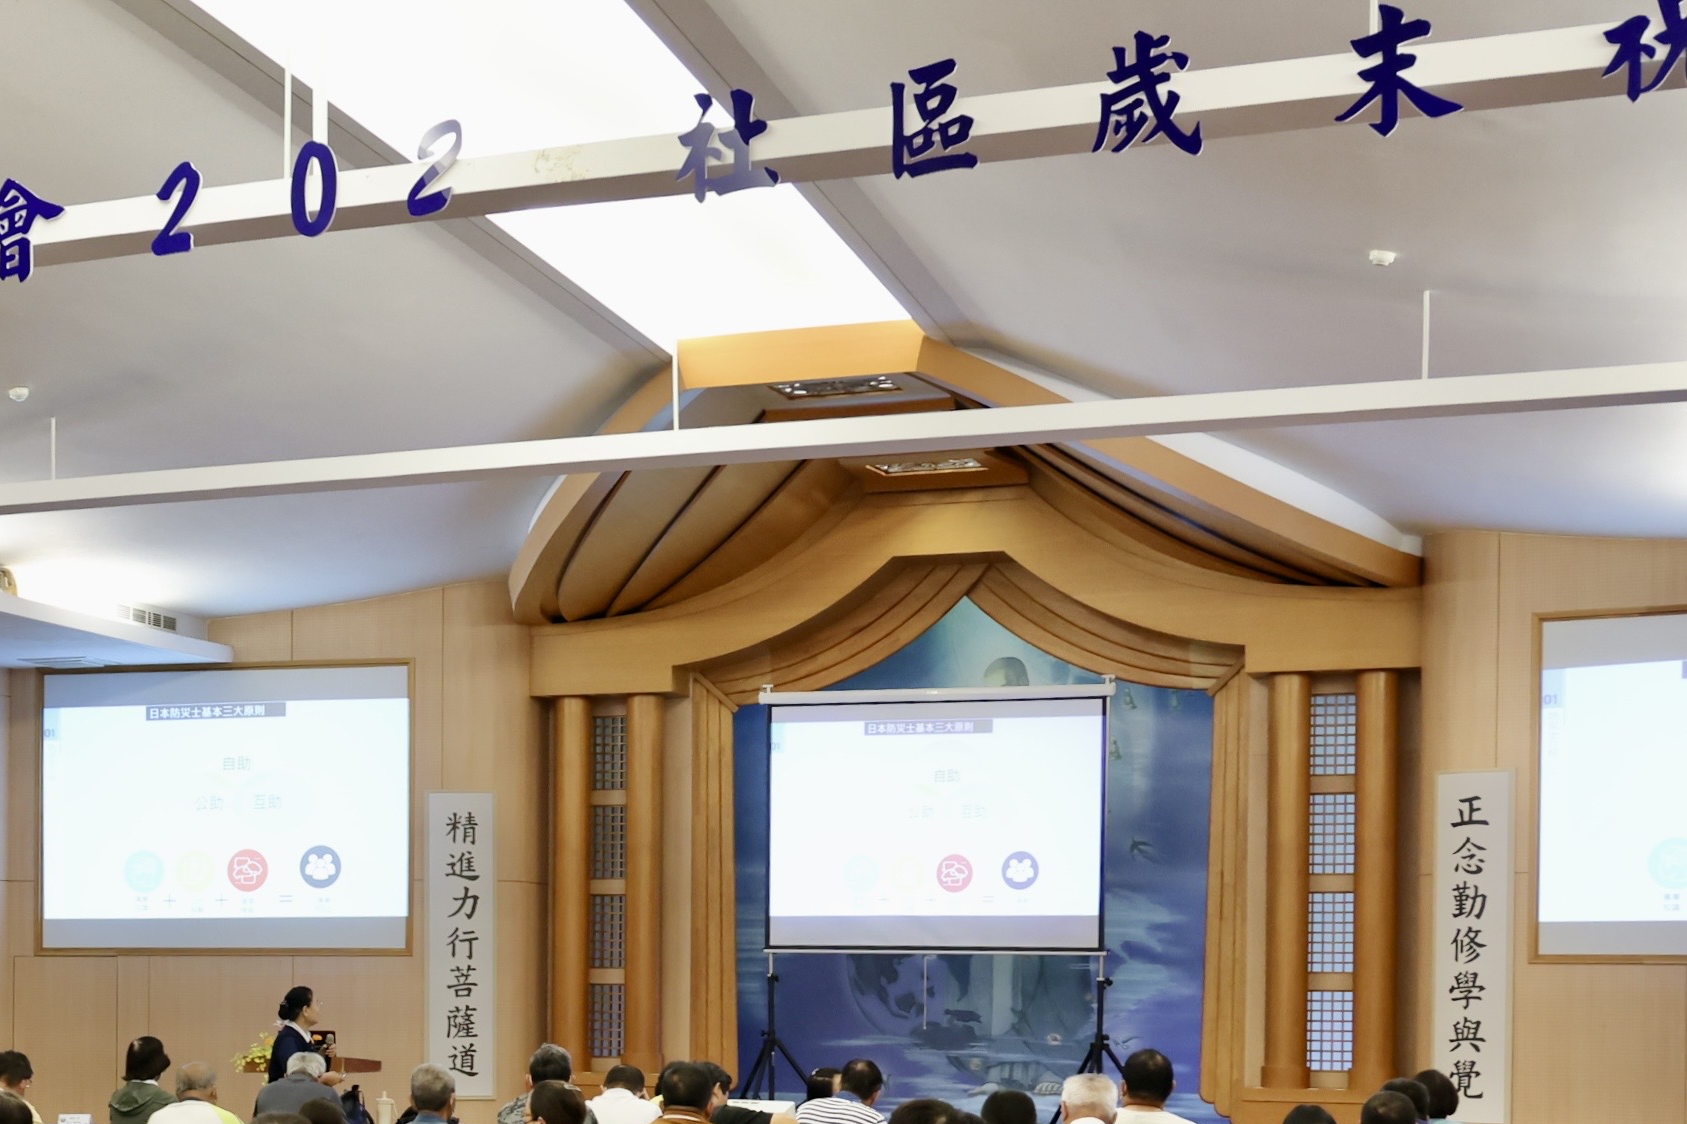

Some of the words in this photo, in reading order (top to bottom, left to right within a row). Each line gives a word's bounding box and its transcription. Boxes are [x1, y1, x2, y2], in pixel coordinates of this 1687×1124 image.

[149, 704, 266, 720] 日本防災士基本三大原則
[444, 811, 481, 1078] 精進力行菩薩道
[1448, 795, 1490, 1100] 正念勤修學與覺
